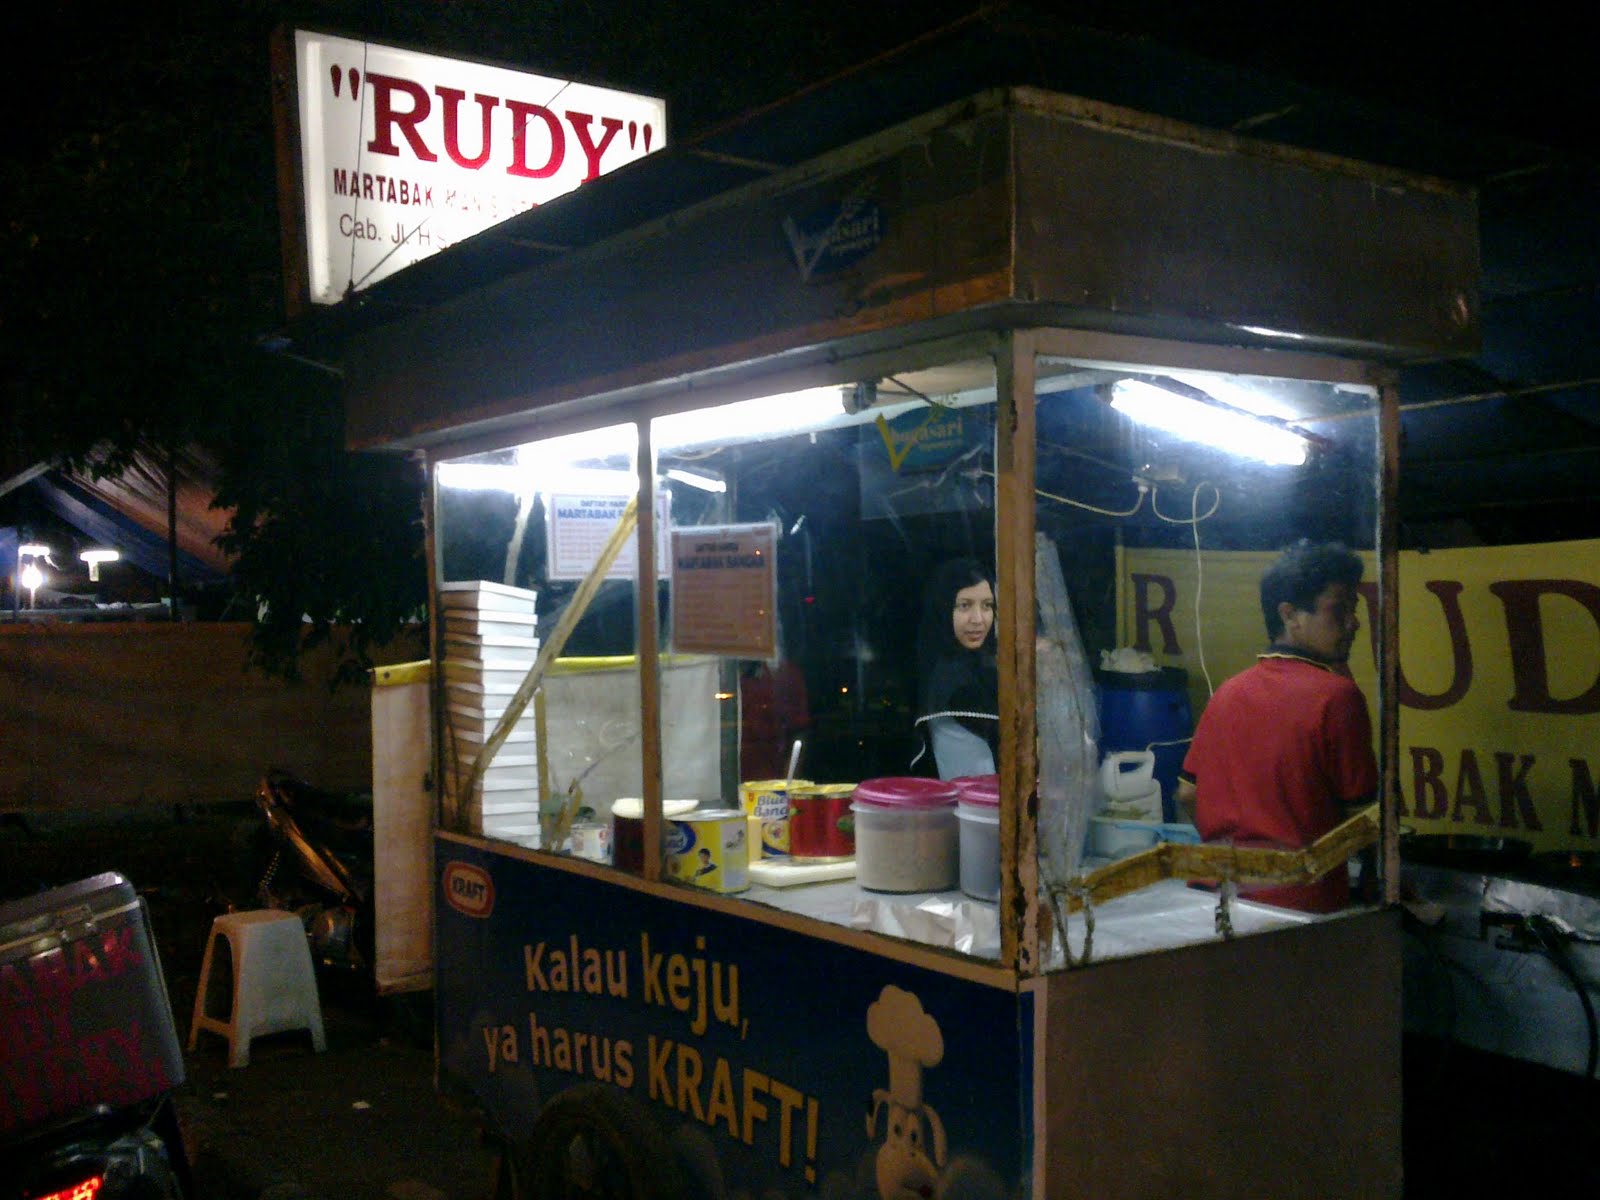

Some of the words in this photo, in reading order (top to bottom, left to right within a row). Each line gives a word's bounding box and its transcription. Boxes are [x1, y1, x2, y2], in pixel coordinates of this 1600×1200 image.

[333, 167, 434, 208] MARTABAK
[339, 213, 382, 241] Cab.
[557, 508, 617, 519] MARTABAK
[757, 794, 786, 806] Blue
[1400, 746, 1543, 832] BAK
[451, 876, 486, 903] KRAFT
[523, 933, 629, 999] Kalau
[640, 931, 749, 1040] keju,
[482, 1022, 519, 1073] ya
[529, 1011, 635, 1089] harus
[647, 1033, 820, 1184] KRAFT!
